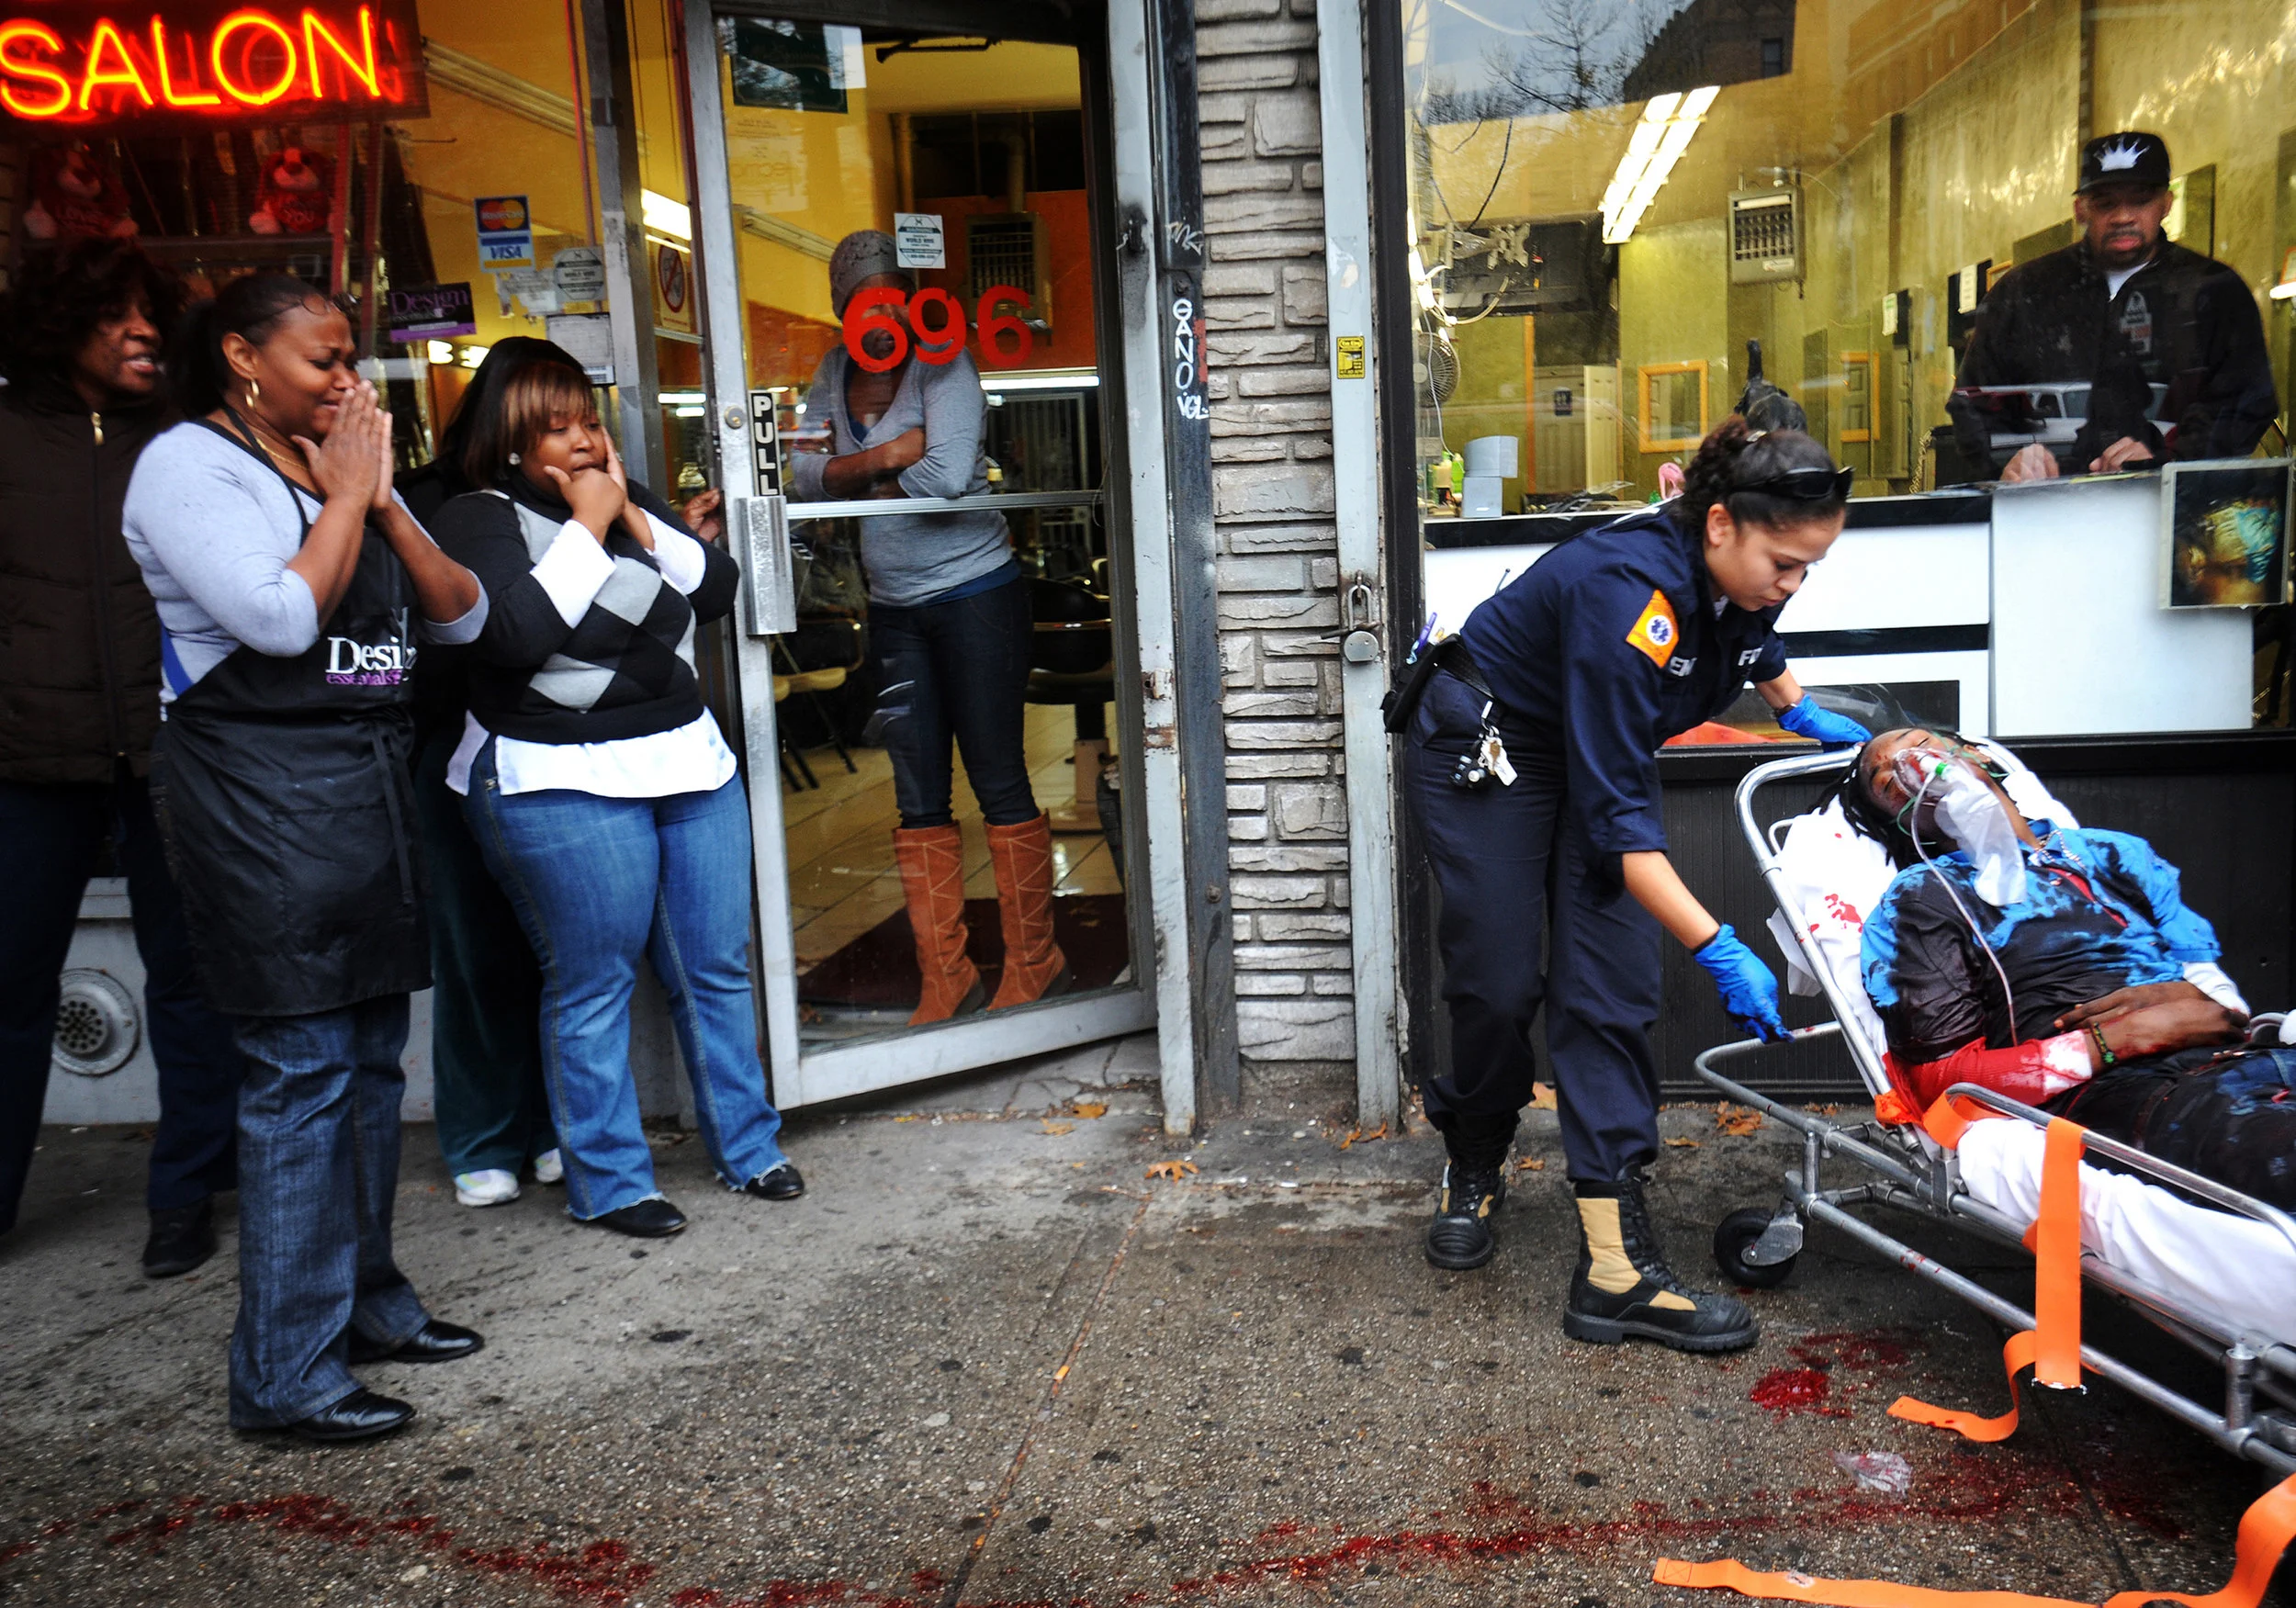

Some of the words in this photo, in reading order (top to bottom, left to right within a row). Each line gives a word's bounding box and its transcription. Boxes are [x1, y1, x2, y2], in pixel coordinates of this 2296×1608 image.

[0, 5, 382, 117] SALON
[490, 245, 523, 260] VISA
[842, 285, 1033, 374] 696
[752, 395, 779, 496] PULL
